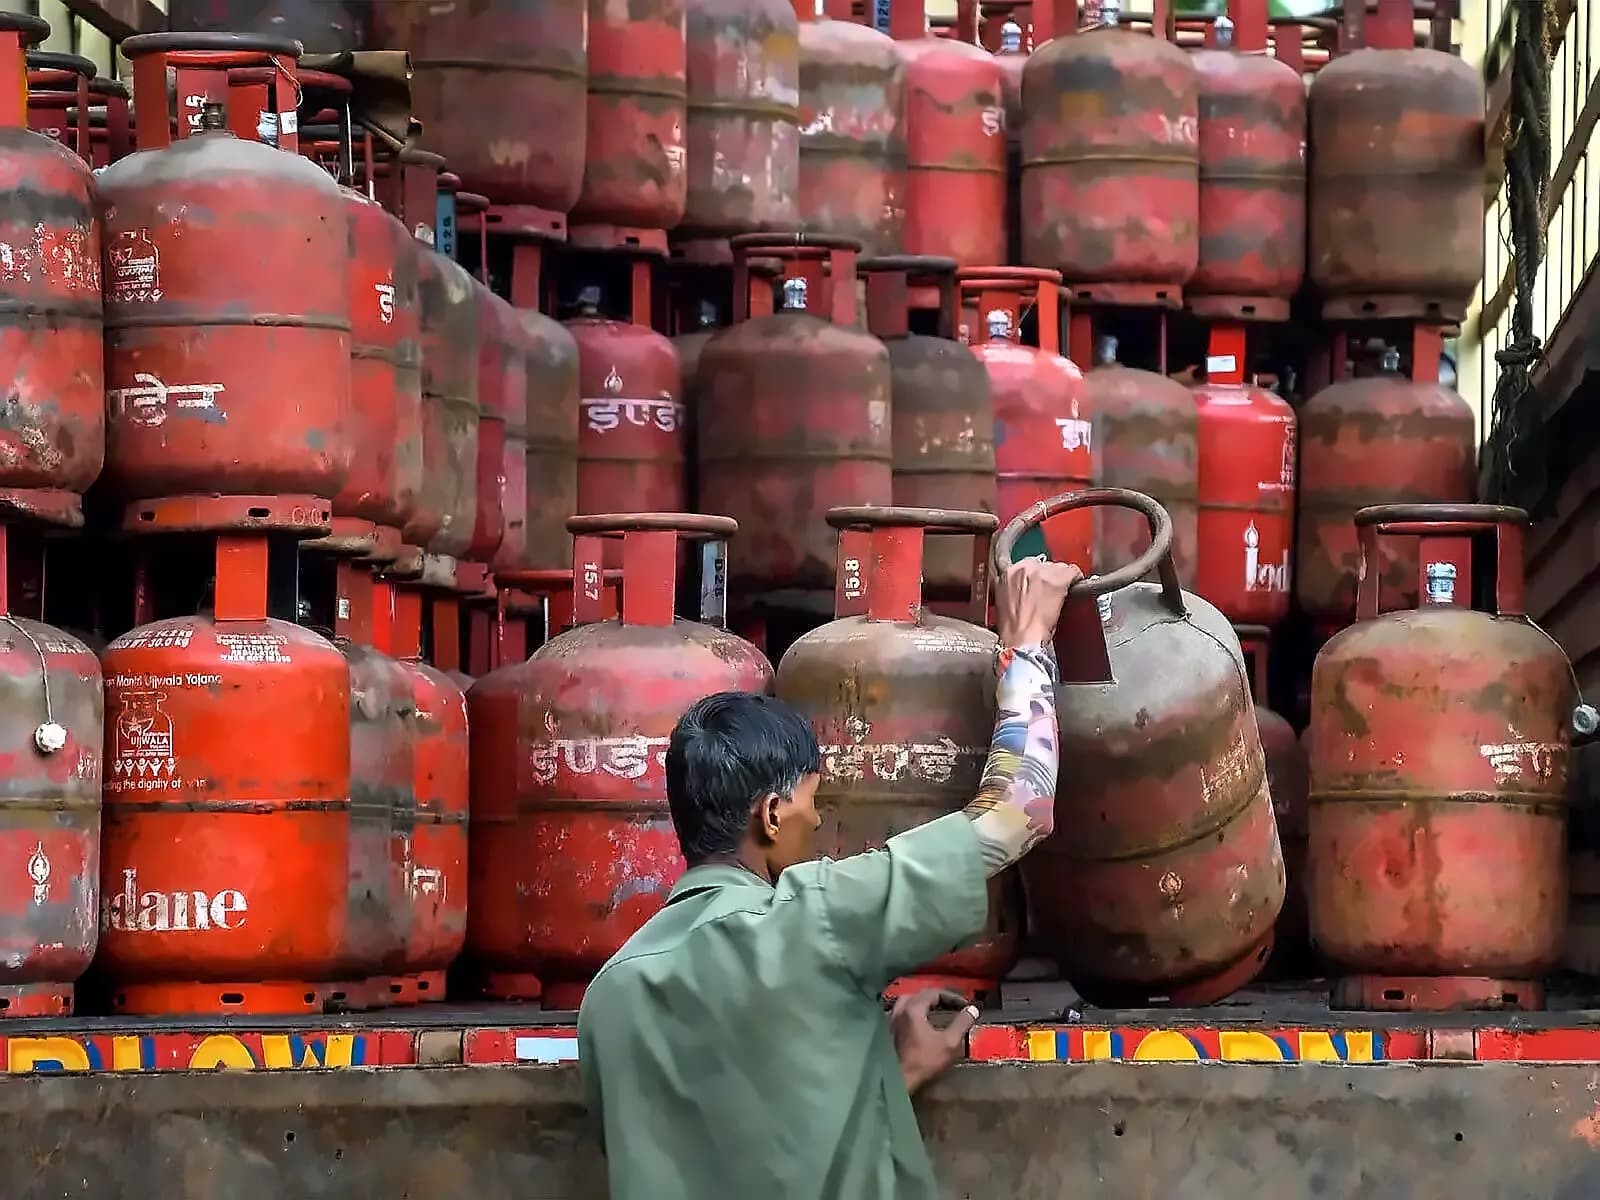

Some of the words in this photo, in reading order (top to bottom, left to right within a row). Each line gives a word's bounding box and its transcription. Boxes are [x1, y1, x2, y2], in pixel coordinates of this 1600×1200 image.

[584, 562, 600, 601] 15.7
[845, 558, 861, 600] 15.8
[174, 637, 190, 649] kg
